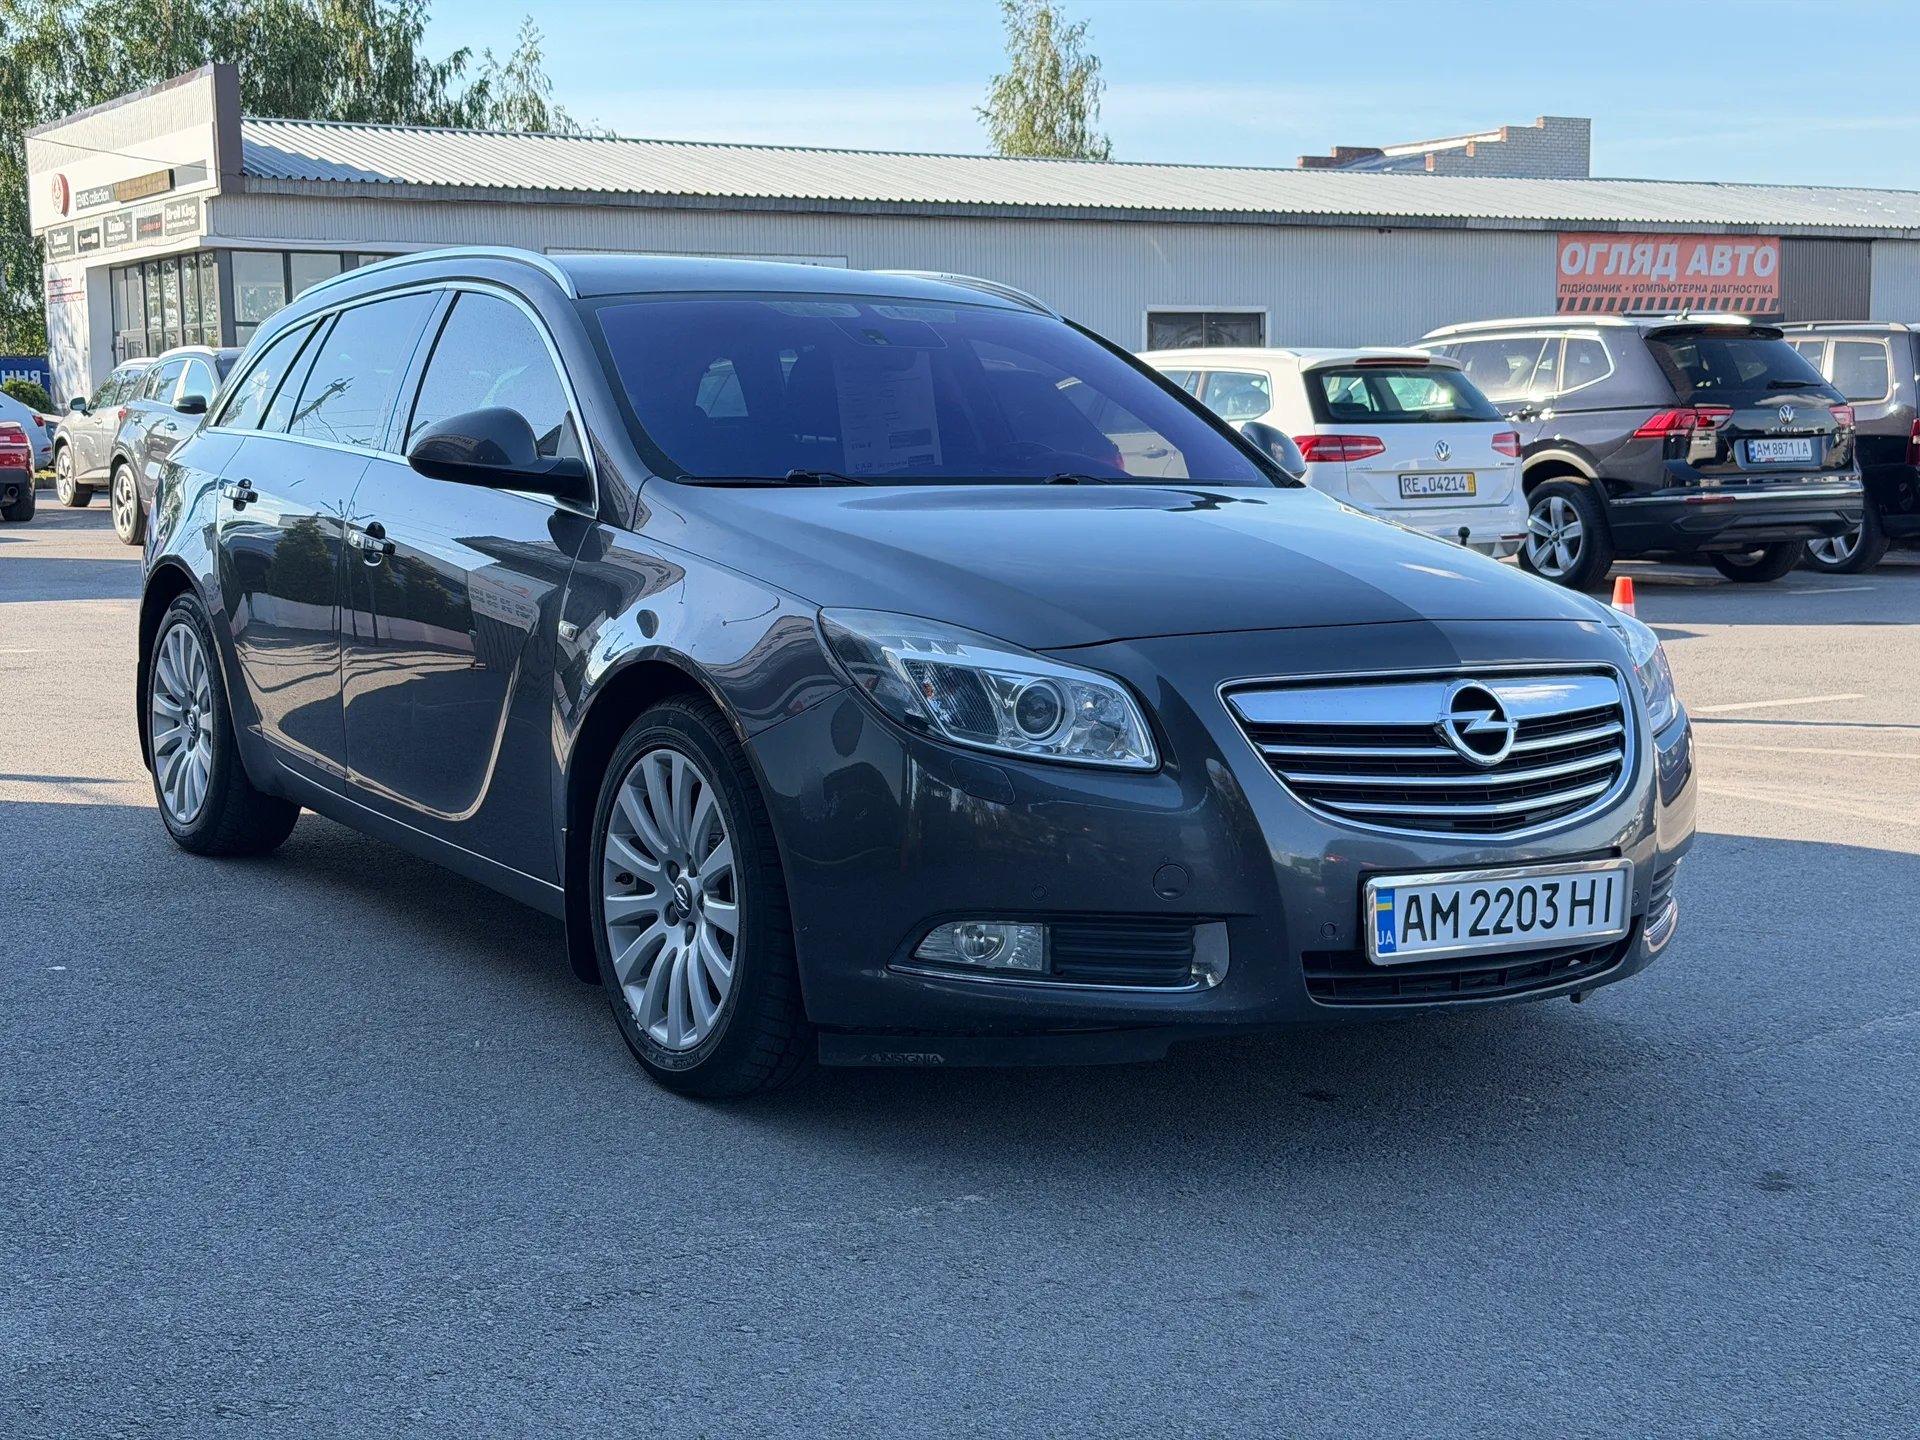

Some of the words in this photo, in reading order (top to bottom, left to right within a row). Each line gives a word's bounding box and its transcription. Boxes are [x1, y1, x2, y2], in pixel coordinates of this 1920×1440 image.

[1560, 243, 1680, 282] ОГЛЯД
[1686, 244, 1777, 277] АВТО
[1560, 281, 1623, 294] ПІДЙОМНИК
[1632, 283, 1709, 295] КОМПЬЮТЕРНА
[1757, 442, 1771, 456] AM
[1772, 442, 1795, 456] 8871
[1401, 891, 1460, 943] AM
[1468, 883, 1561, 937] 2203
[1568, 877, 1613, 927] HI
[1377, 930, 1394, 946] UA
